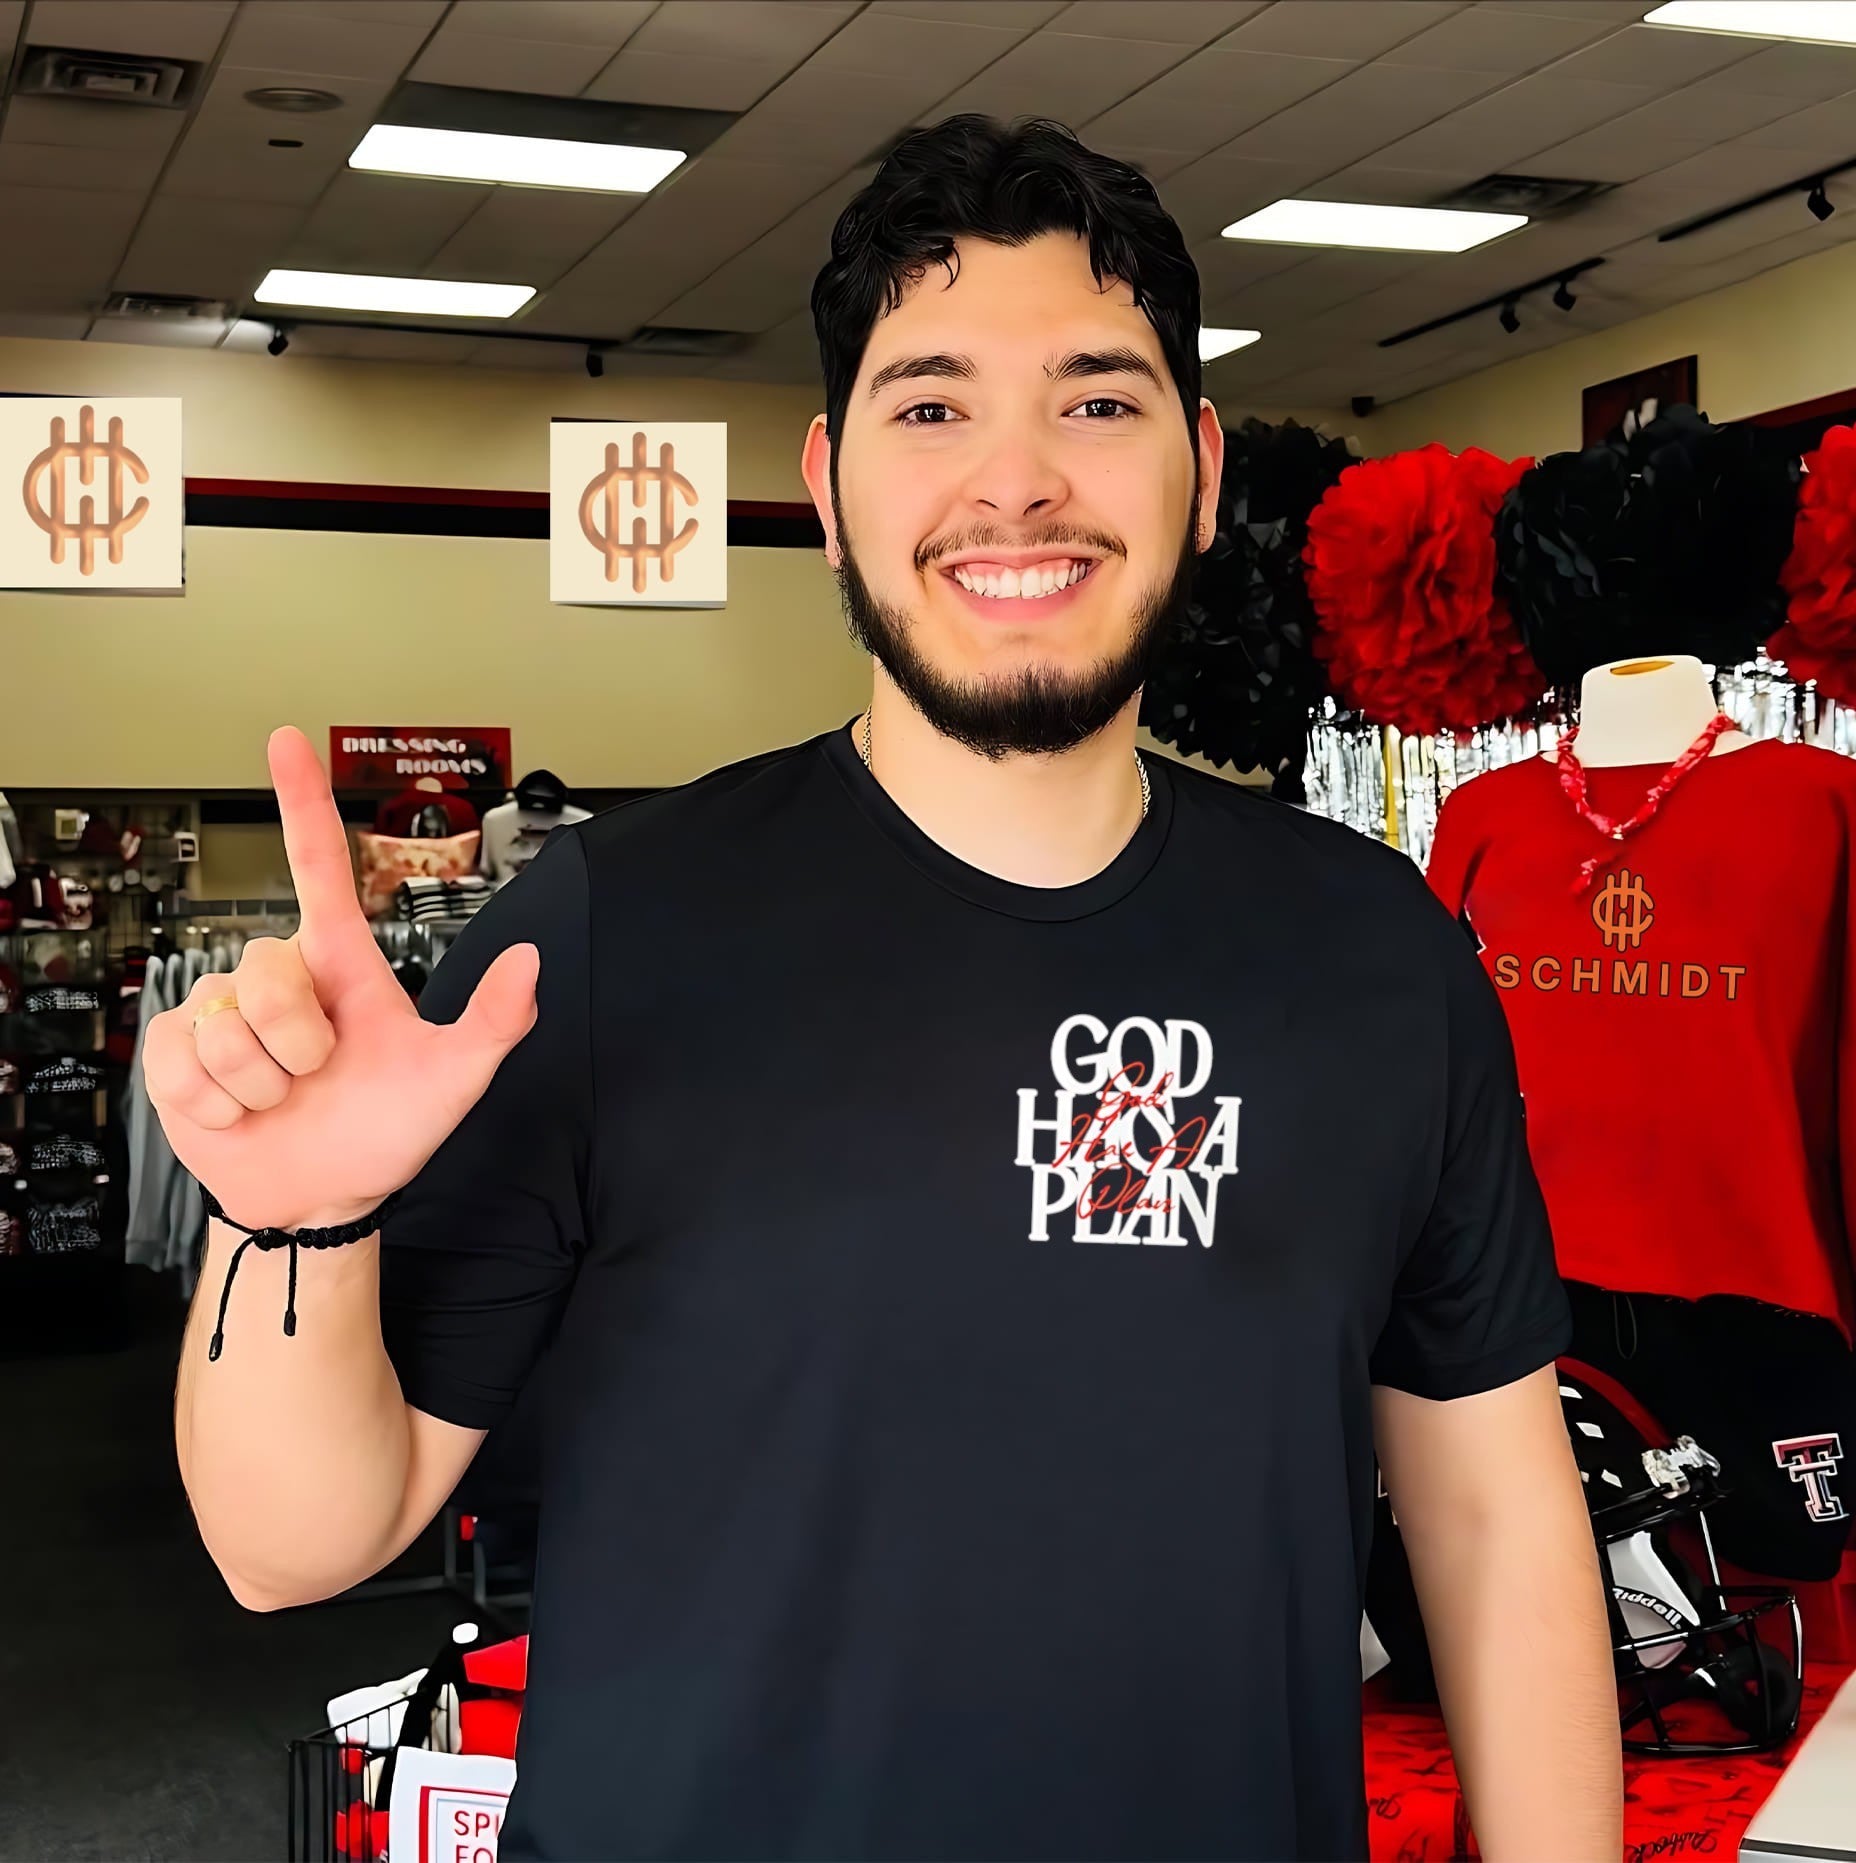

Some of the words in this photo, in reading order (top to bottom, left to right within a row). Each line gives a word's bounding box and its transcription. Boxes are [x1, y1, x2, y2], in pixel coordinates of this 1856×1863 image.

[342, 737, 466, 753] DRESSING
[396, 758, 487, 775] ROOMS
[1494, 954, 1747, 1000] SCHMIDT
[1050, 1014, 1213, 1097] GOD
[1014, 1088, 1177, 1172] HAS
[1188, 1096, 1242, 1175] A
[1028, 1164, 1223, 1247] PLAN
[1076, 1163, 1175, 1219] Plan
